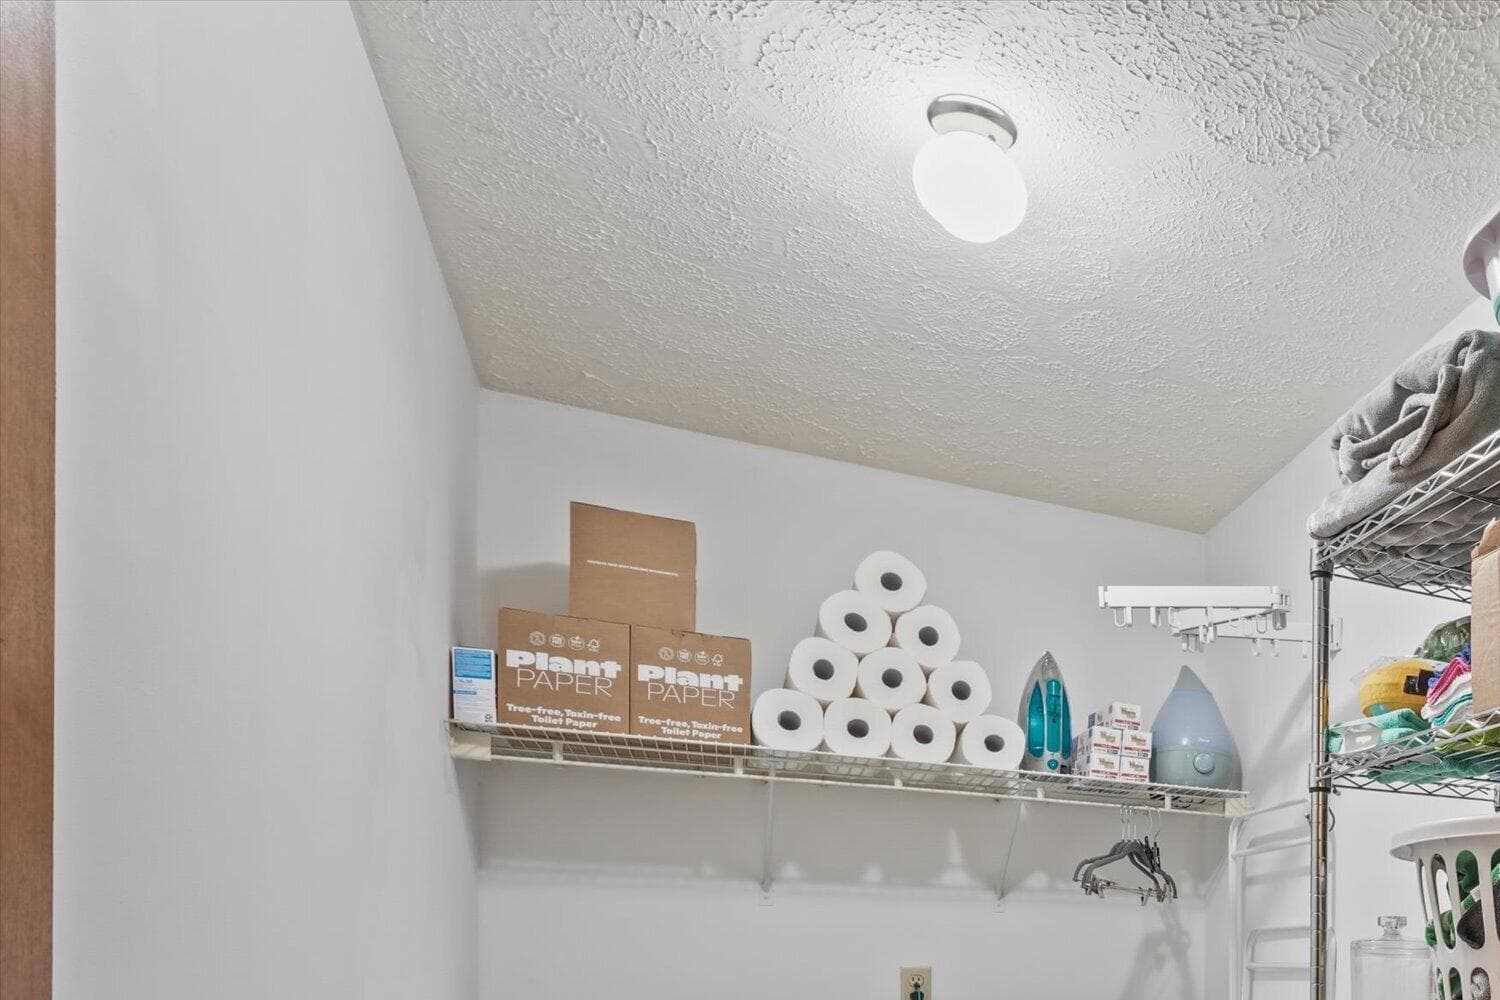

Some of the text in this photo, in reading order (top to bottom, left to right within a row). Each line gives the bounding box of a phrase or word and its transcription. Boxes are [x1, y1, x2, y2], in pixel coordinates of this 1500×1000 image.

[506, 649, 622, 679] Plant
[516, 668, 613, 697] PAPER
[637, 664, 744, 692] Plant
[647, 682, 735, 709] PAPER
[506, 703, 621, 722] Tree-free, Toxin-free
[531, 714, 599, 728] Toilet Paper
[638, 715, 744, 733] Tree-free, Toxin-free
[661, 726, 722, 739] Toilet Paper
